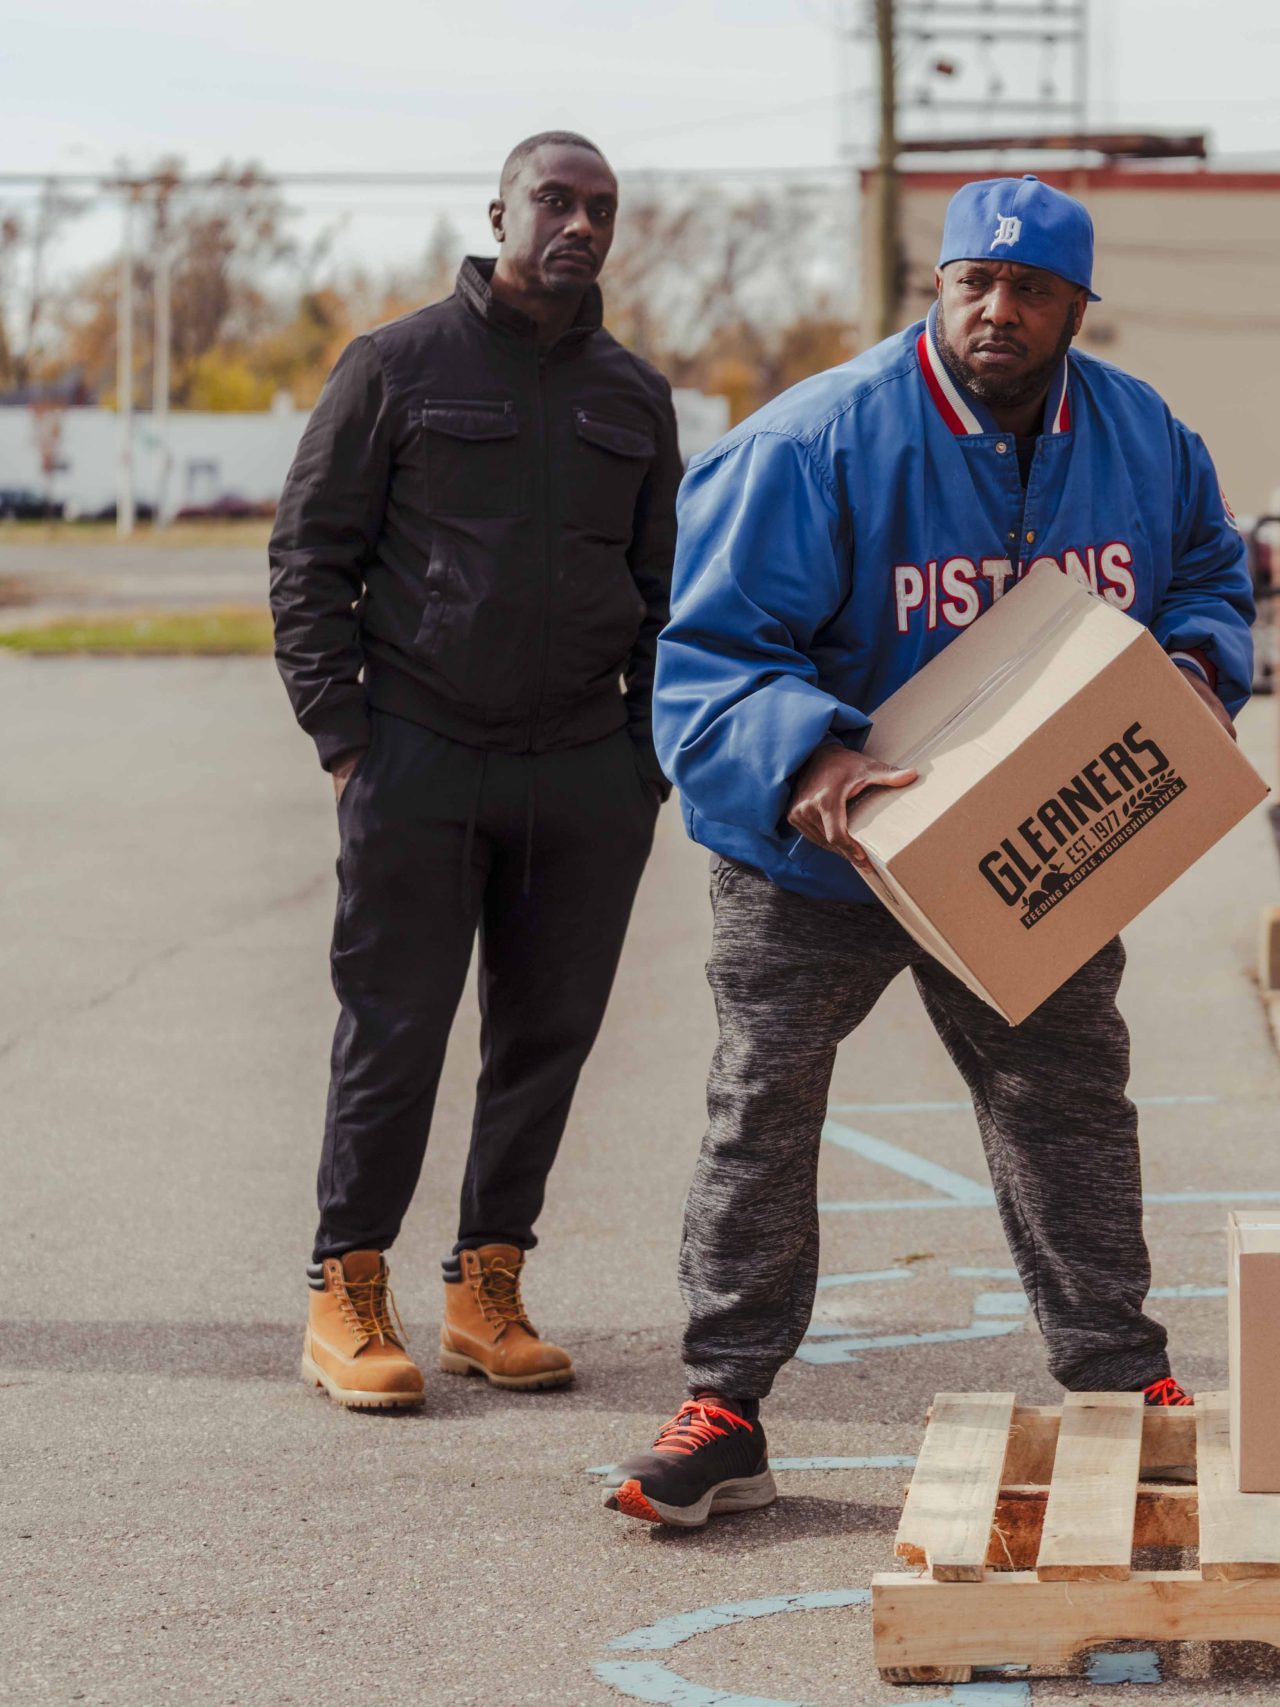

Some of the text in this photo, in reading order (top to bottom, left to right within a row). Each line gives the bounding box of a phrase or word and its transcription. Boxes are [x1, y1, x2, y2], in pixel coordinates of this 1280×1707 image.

[895, 541, 1136, 633] PISTNS
[978, 721, 1170, 907] GLEANERS
[1024, 784, 1184, 925] FEEDING PEOPLE. NOURISHING LIVES.
[1066, 809, 1121, 865] EST. 1977
